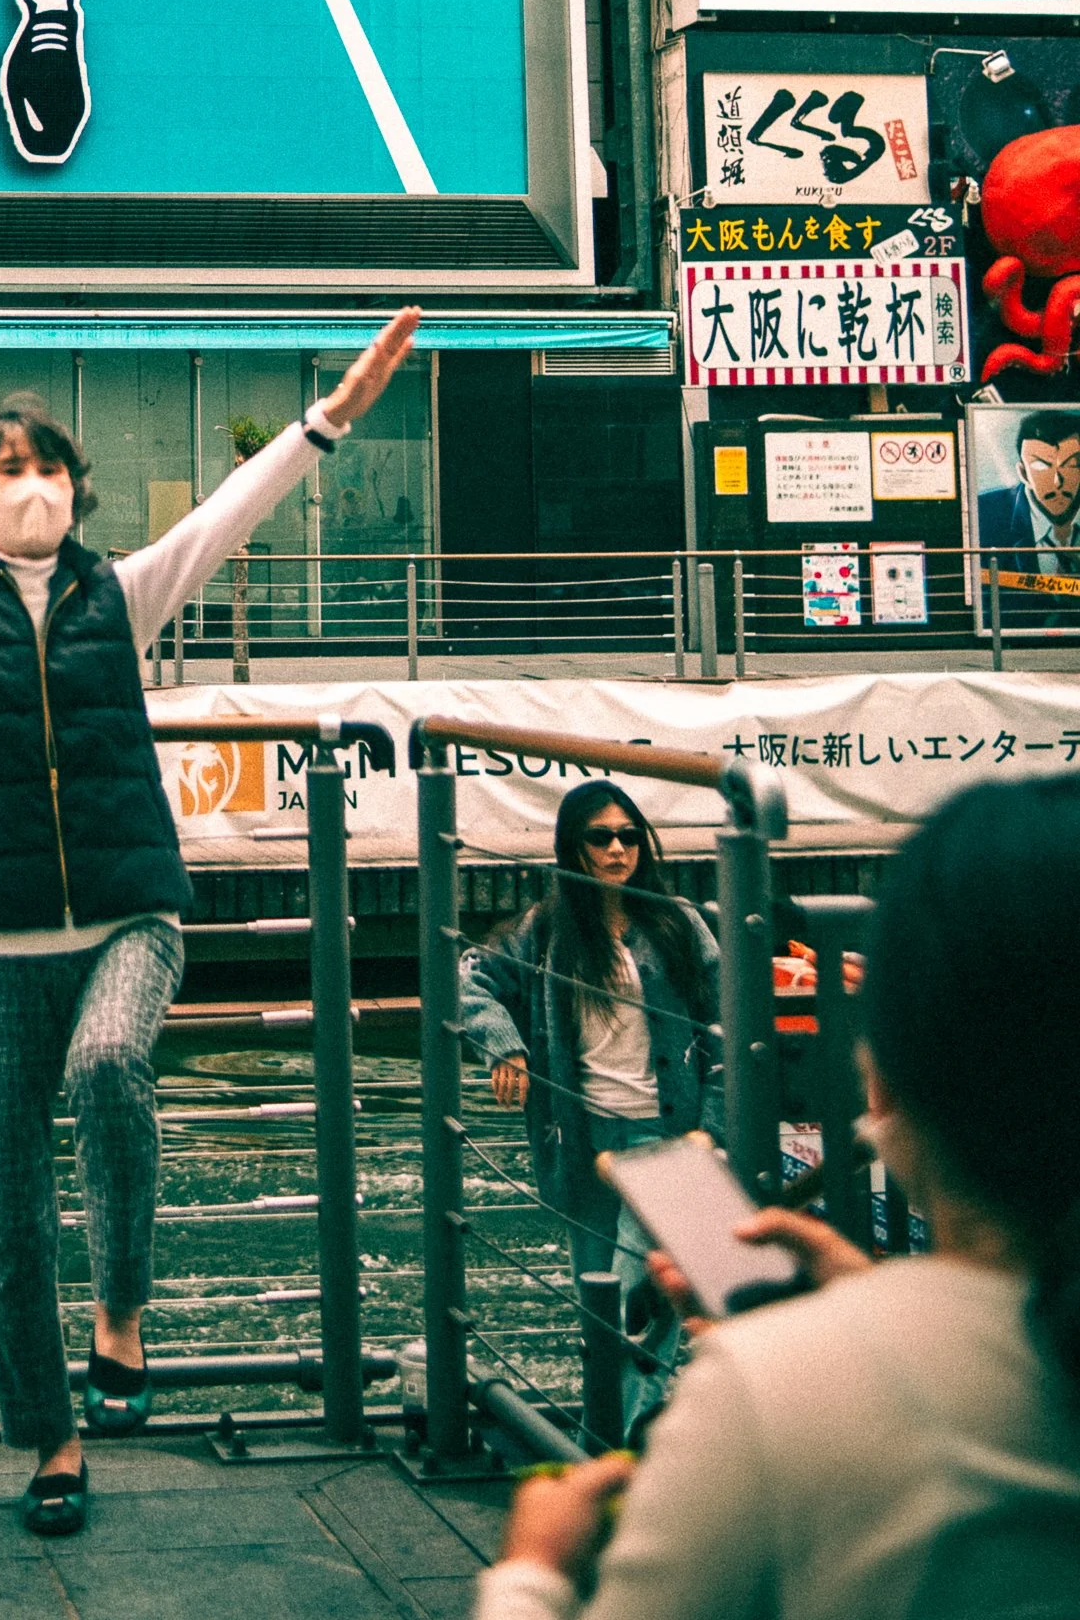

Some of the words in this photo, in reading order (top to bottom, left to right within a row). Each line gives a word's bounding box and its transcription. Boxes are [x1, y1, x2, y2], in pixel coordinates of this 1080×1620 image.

[716, 85, 746, 188] 道頓堀
[795, 186, 843, 197] KUKU
[686, 214, 882, 253] 大阪もんを食す
[923, 235, 957, 256] 2F
[701, 281, 926, 364] 大阪に乾杯
[934, 292, 956, 345] 検索
[722, 730, 1080, 769] 大阪に新しいエンターテ
[278, 791, 357, 811] JAN
